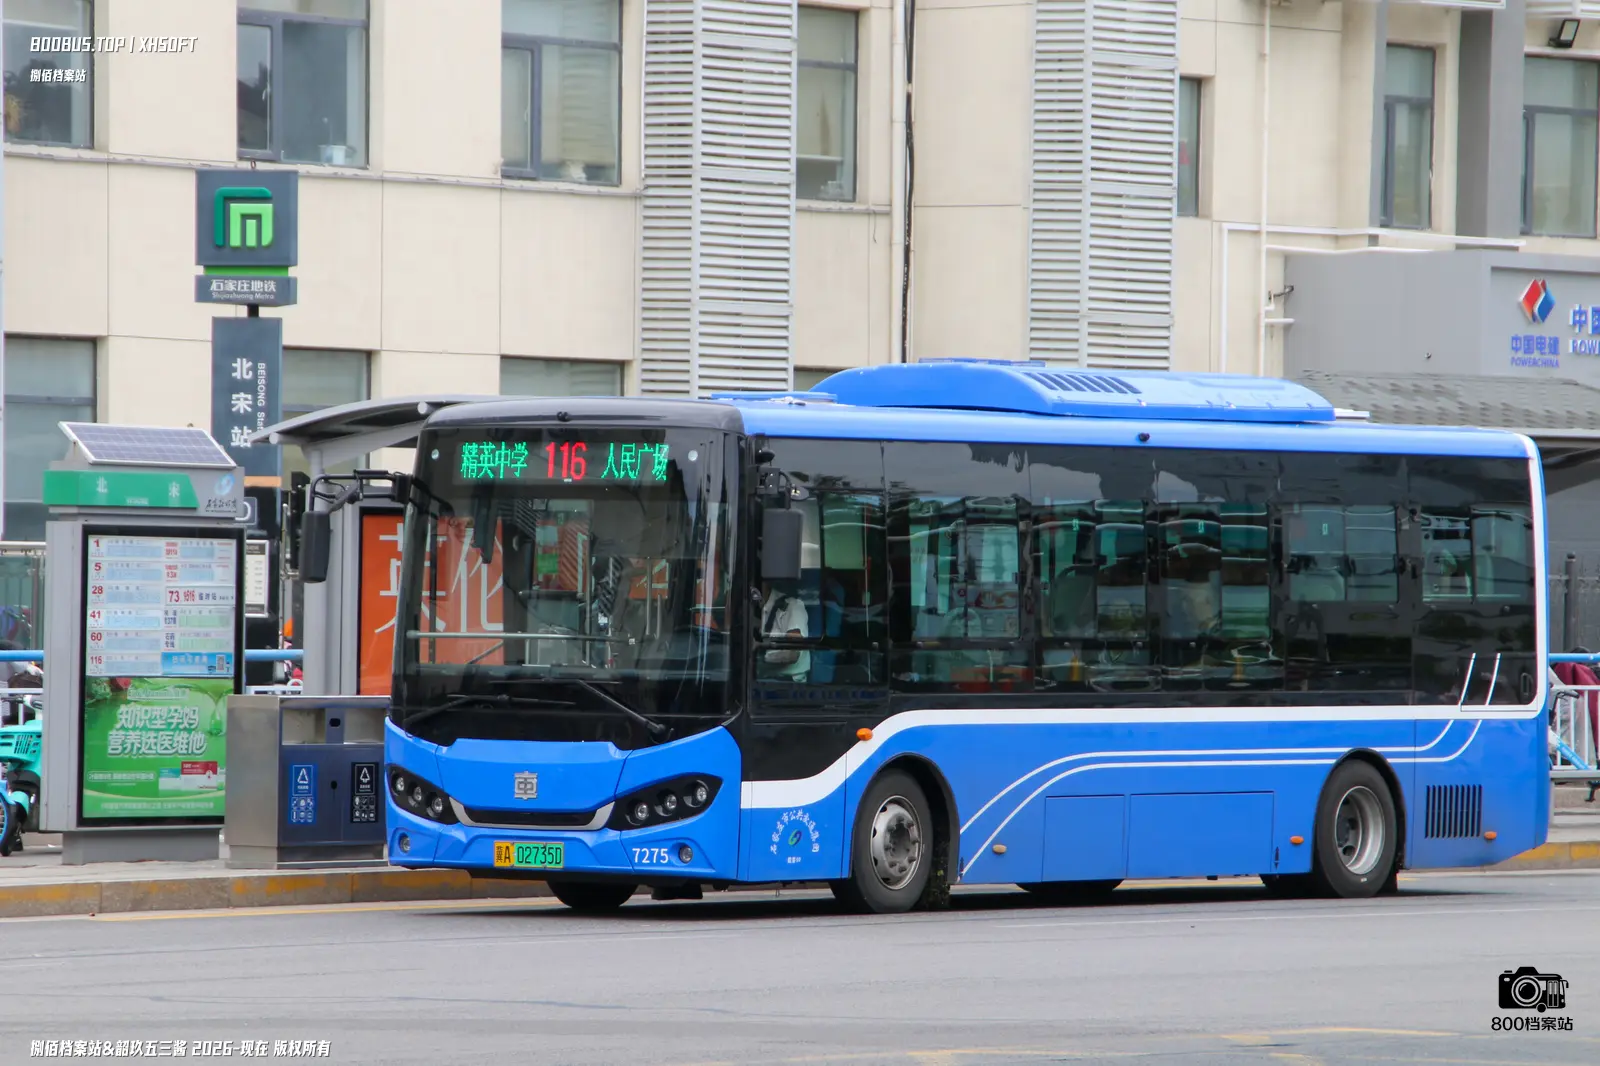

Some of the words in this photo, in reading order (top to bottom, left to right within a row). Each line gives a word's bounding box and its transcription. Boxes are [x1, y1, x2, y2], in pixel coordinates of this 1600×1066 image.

[210, 279, 276, 292] 石家庄地铁
[254, 292, 275, 300] Metro
[1511, 334, 1560, 355] 中国电建
[1568, 339, 1600, 355] POW
[1511, 356, 1560, 368] POWERCHINA
[257, 362, 266, 407] BEISONG
[231, 357, 253, 448] 北宋站
[257, 411, 266, 432] Stat
[460, 441, 529, 479] 精英中学
[545, 441, 588, 481] 116
[600, 442, 670, 481] 人民广场
[92, 538, 101, 548] 1
[94, 562, 102, 572] 5
[91, 585, 104, 595] 28
[168, 590, 180, 603] 73
[89, 610, 102, 619] 41
[90, 632, 102, 641] 60
[116, 705, 200, 730] 知识型孕妈
[107, 730, 206, 757] 营养选医维他
[632, 847, 669, 864] 7275
